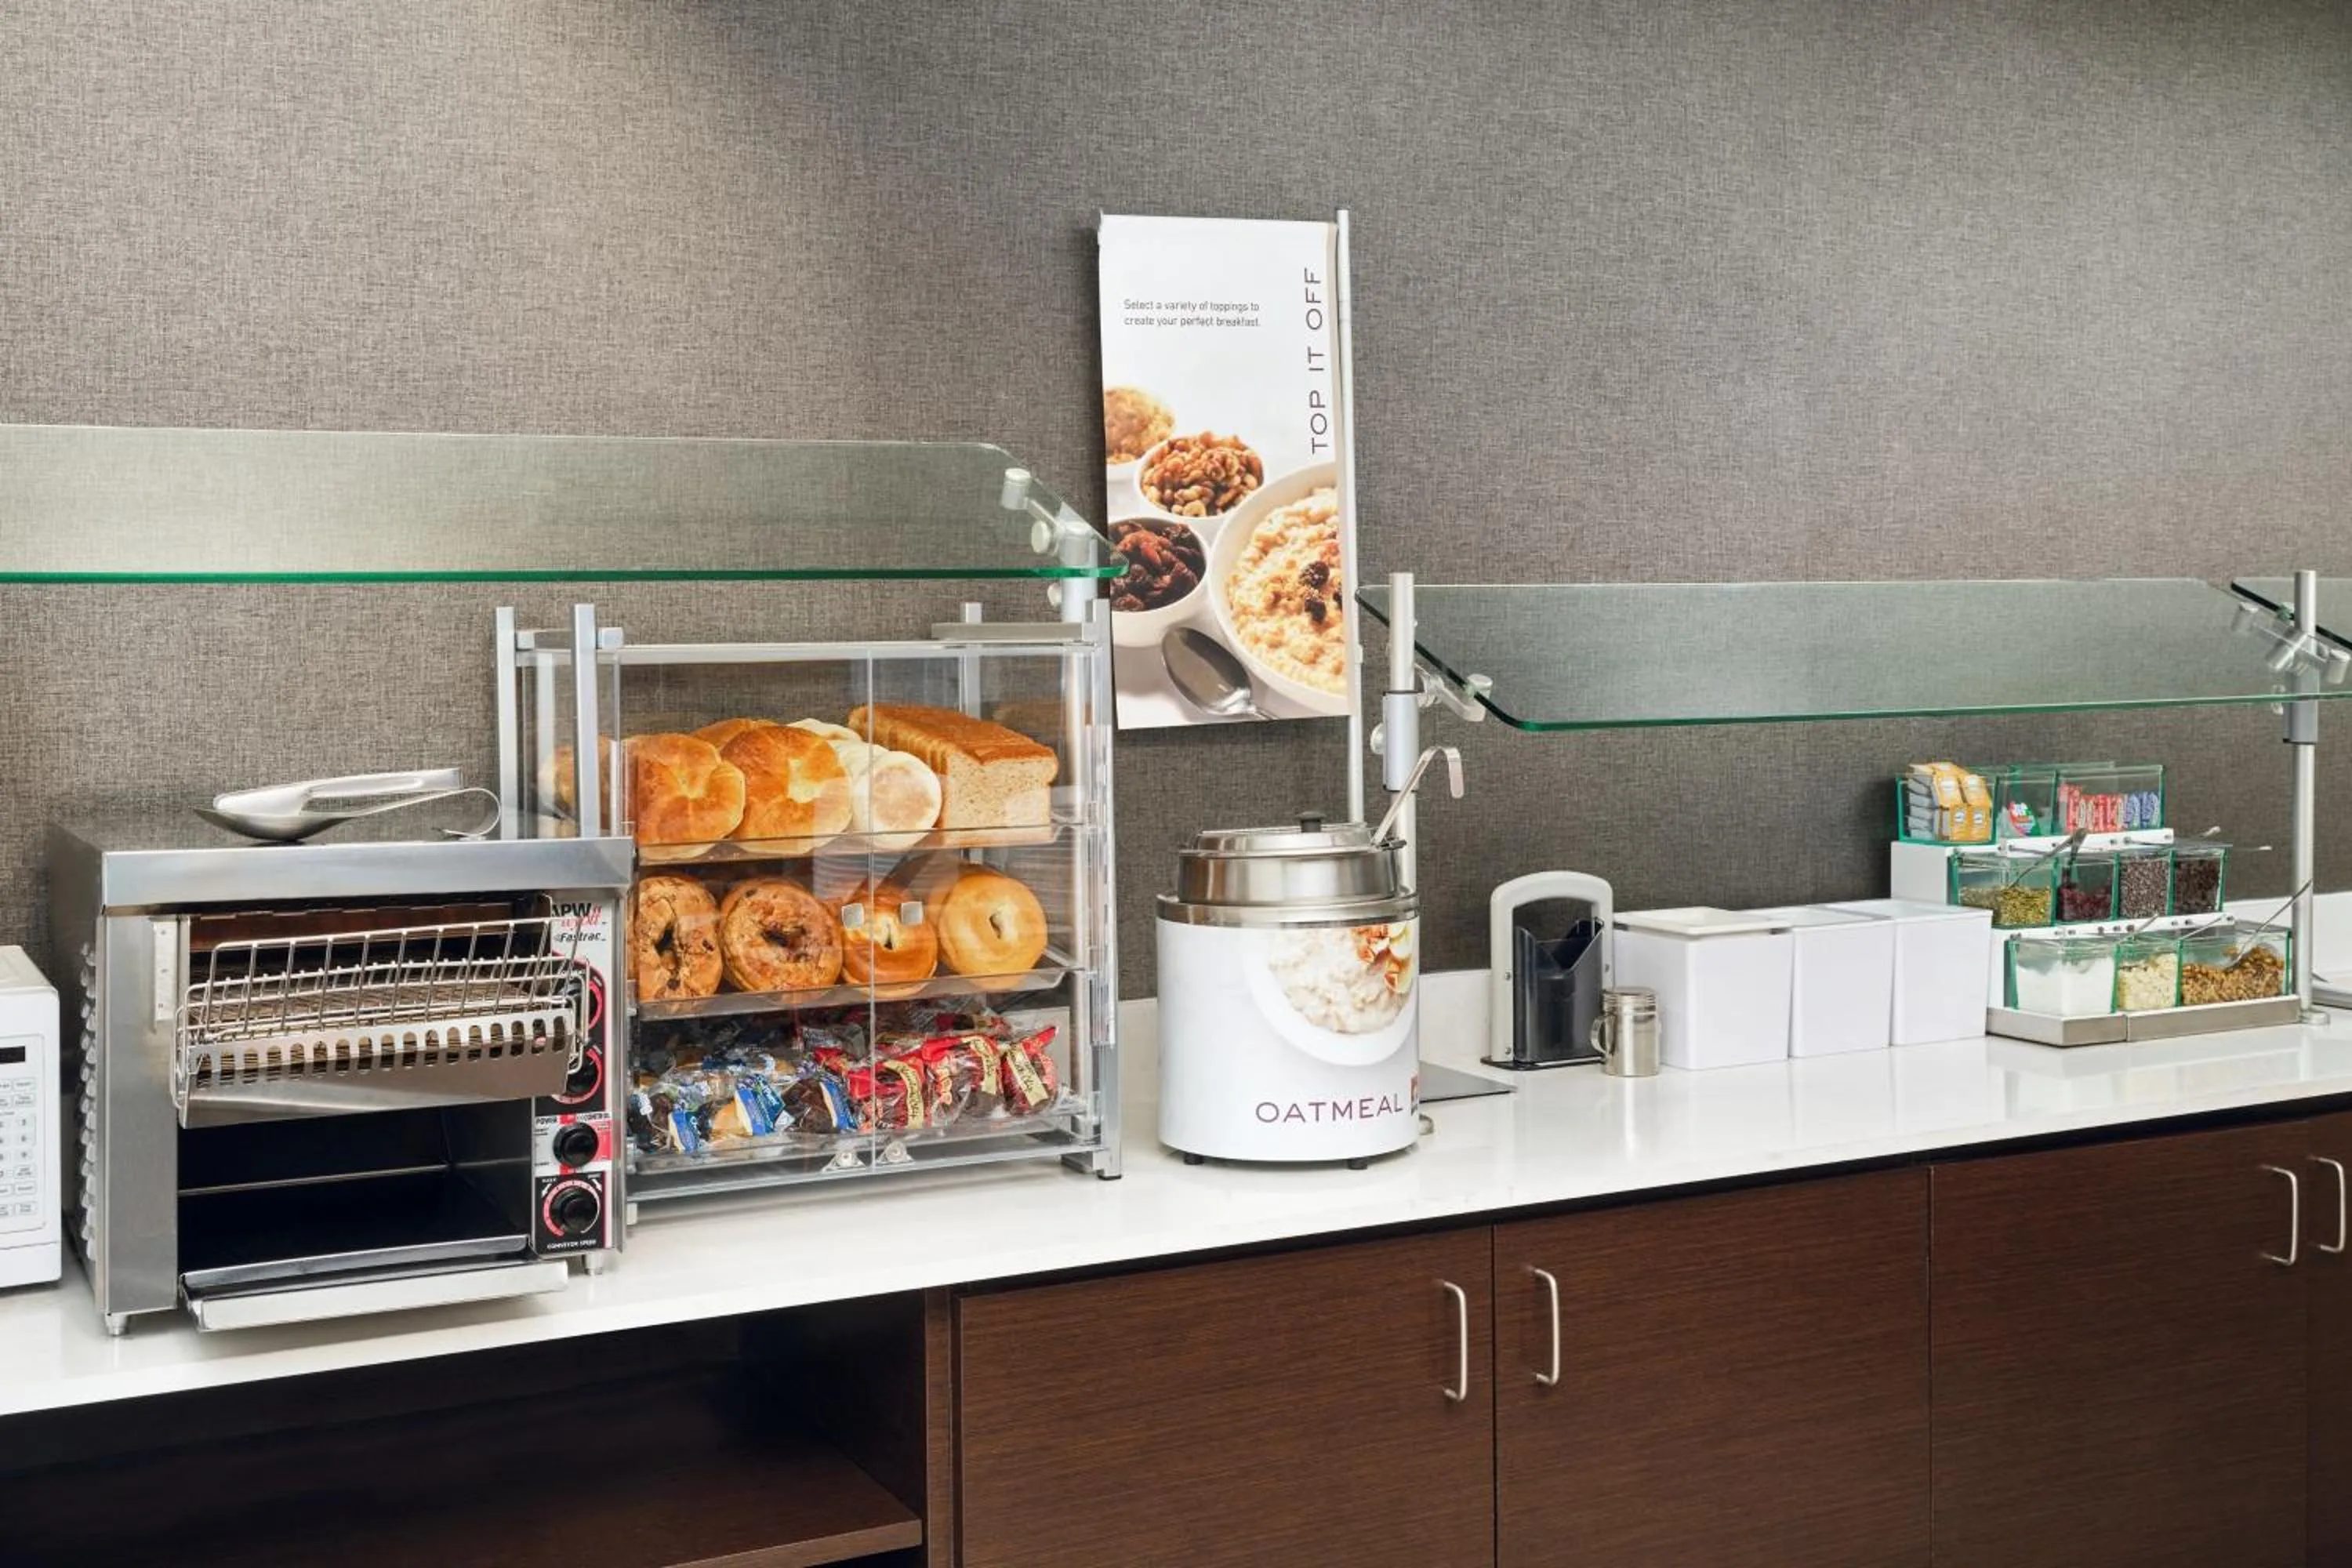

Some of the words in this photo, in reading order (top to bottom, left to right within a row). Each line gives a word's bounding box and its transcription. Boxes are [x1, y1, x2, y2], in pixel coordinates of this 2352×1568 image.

[1123, 299, 1154, 310] Select
[1156, 301, 1163, 310] a
[1164, 301, 1197, 311] variety
[1199, 301, 1208, 310] of
[1210, 302, 1249, 313] toppings
[1250, 303, 1260, 311] to
[1304, 267, 1323, 331] OFF
[1124, 316, 1155, 325] create
[1157, 317, 1178, 327] your
[1180, 316, 1214, 327] perfect
[1216, 317, 1261, 327] breakfast.
[1307, 347, 1325, 372] IT
[1309, 390, 1329, 455] TOP
[1255, 1093, 1403, 1123] OATMEAL
